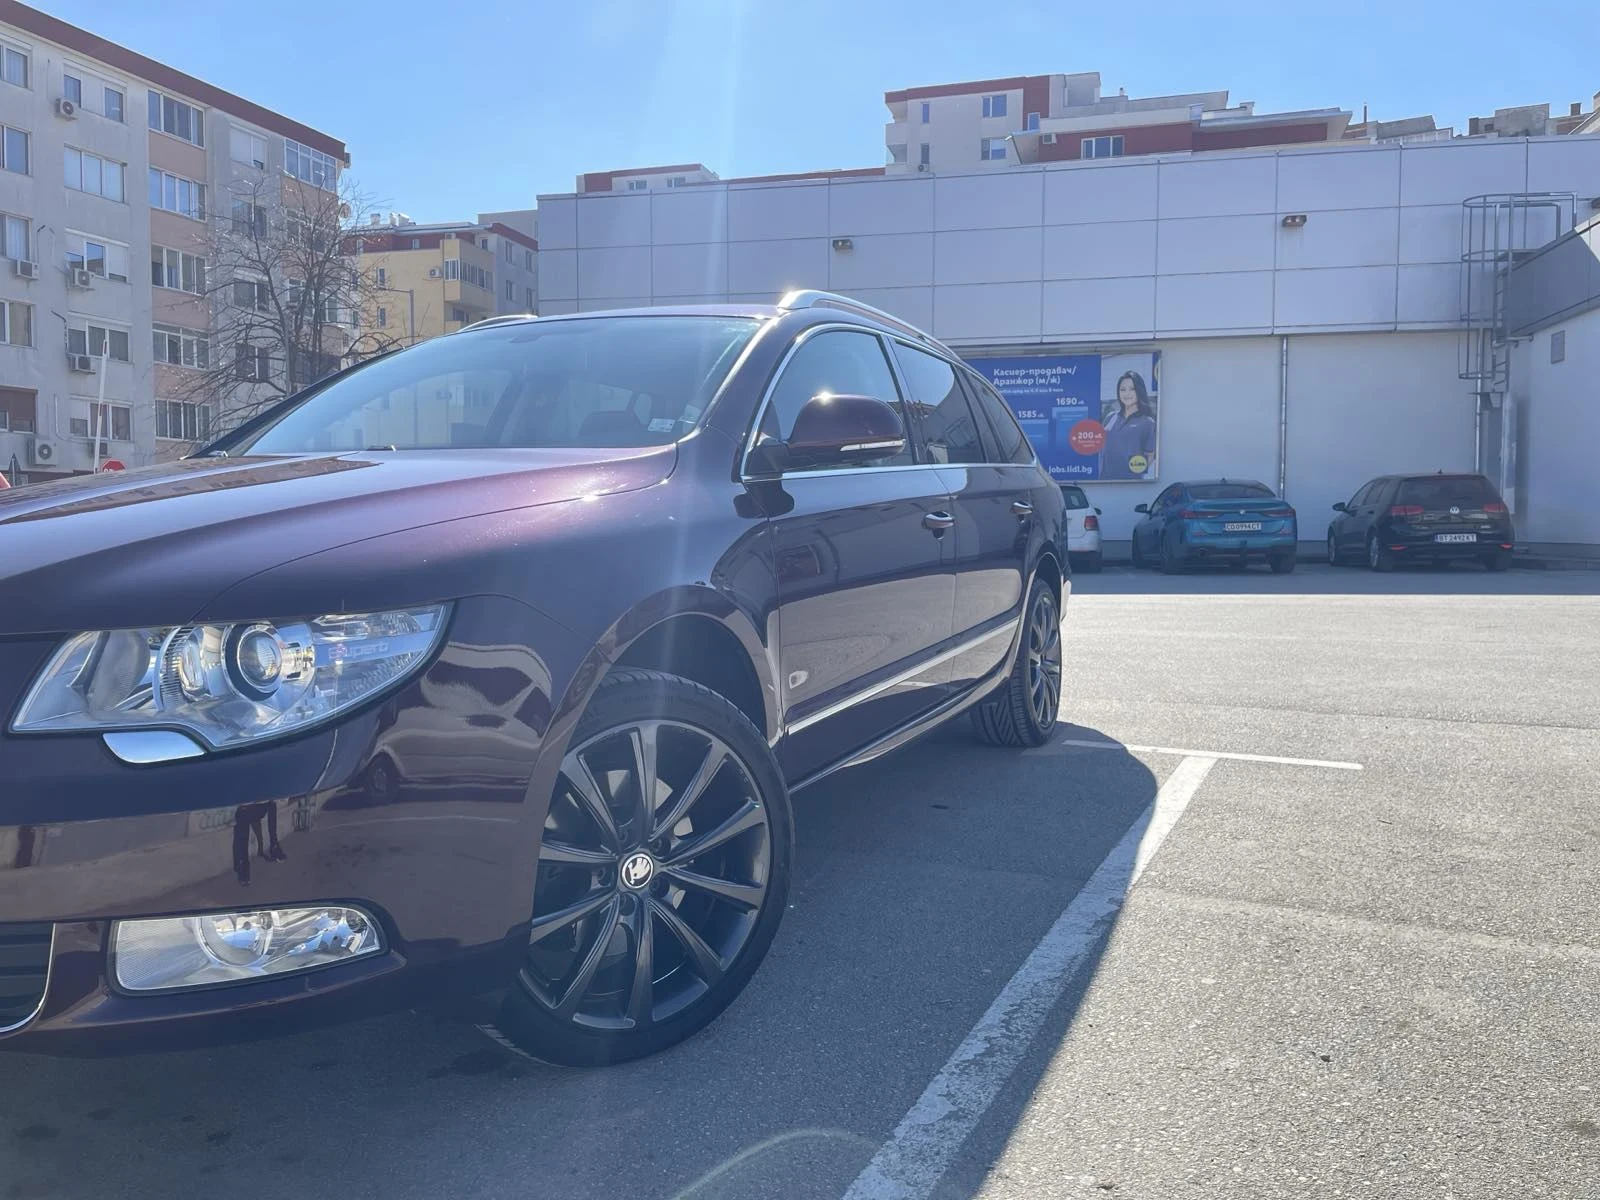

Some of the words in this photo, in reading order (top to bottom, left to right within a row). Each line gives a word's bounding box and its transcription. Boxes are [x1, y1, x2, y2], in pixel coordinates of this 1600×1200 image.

[1056, 397, 1077, 406] 1690
[1018, 410, 1037, 418] 1585
[1048, 465, 1093, 474] jobs.lidl.bg
